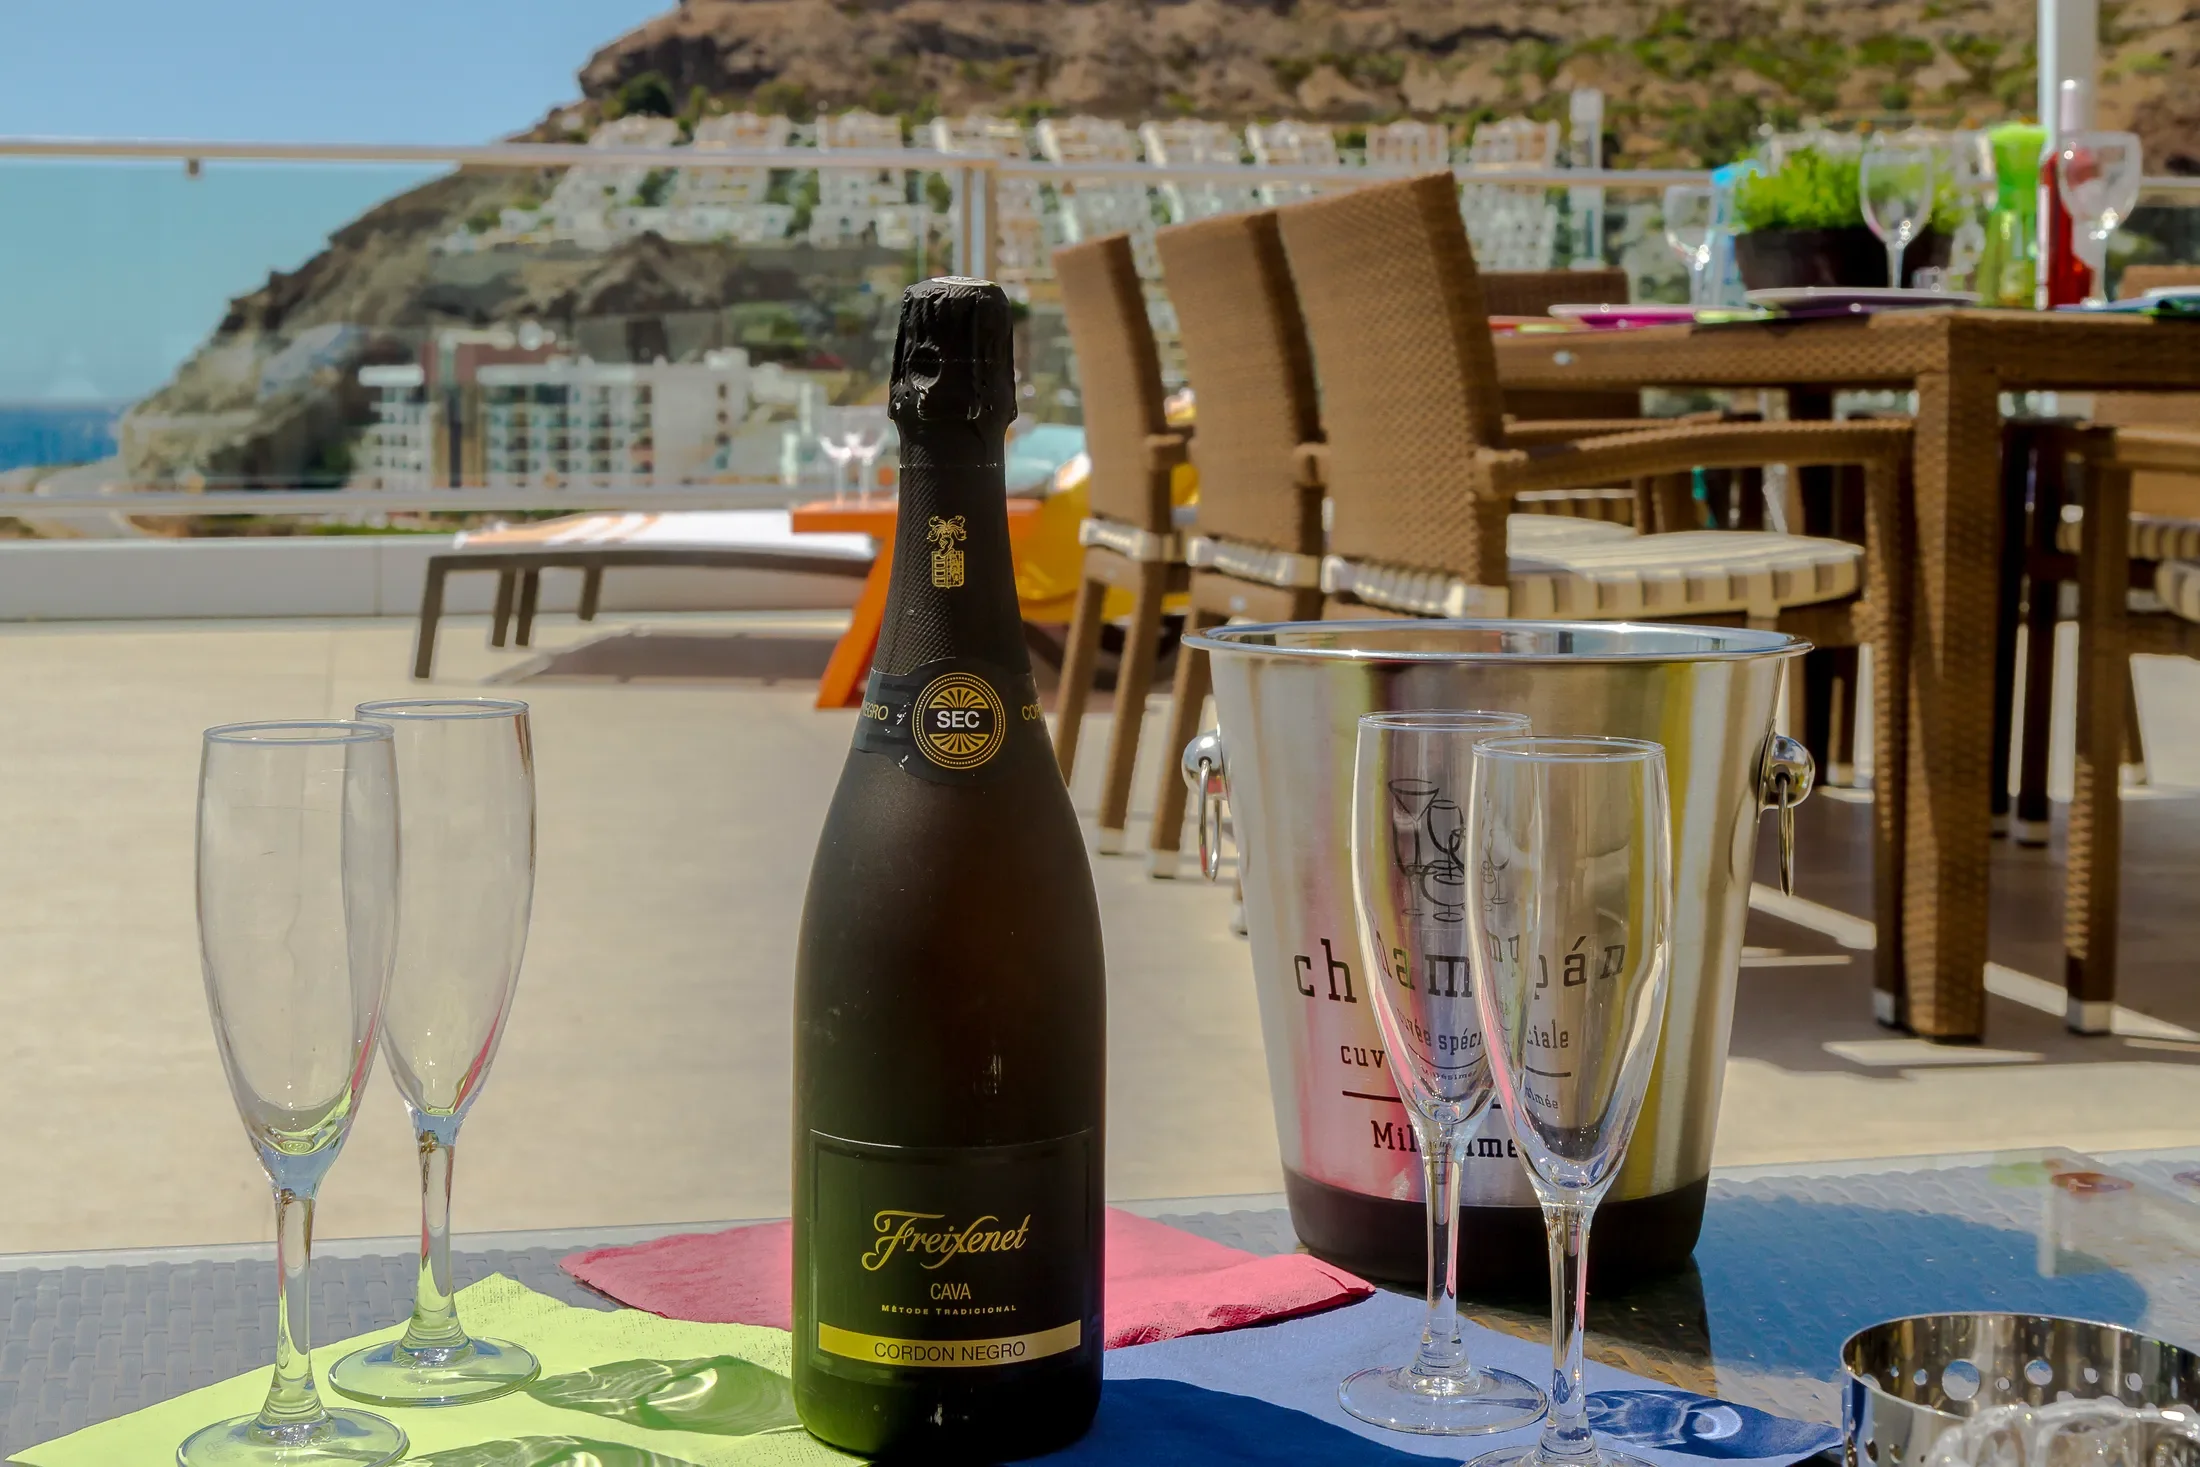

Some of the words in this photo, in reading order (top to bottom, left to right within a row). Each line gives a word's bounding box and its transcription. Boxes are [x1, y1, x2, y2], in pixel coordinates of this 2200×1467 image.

[936, 710, 980, 729] SEC
[1021, 704, 1042, 721] COR
[861, 1209, 1031, 1271] Freixenet
[930, 1282, 972, 1300] CAVA
[935, 1304, 1017, 1316] TRADICIONAL
[874, 1342, 955, 1362] CORDON
[961, 1340, 1026, 1362] NEGRO
